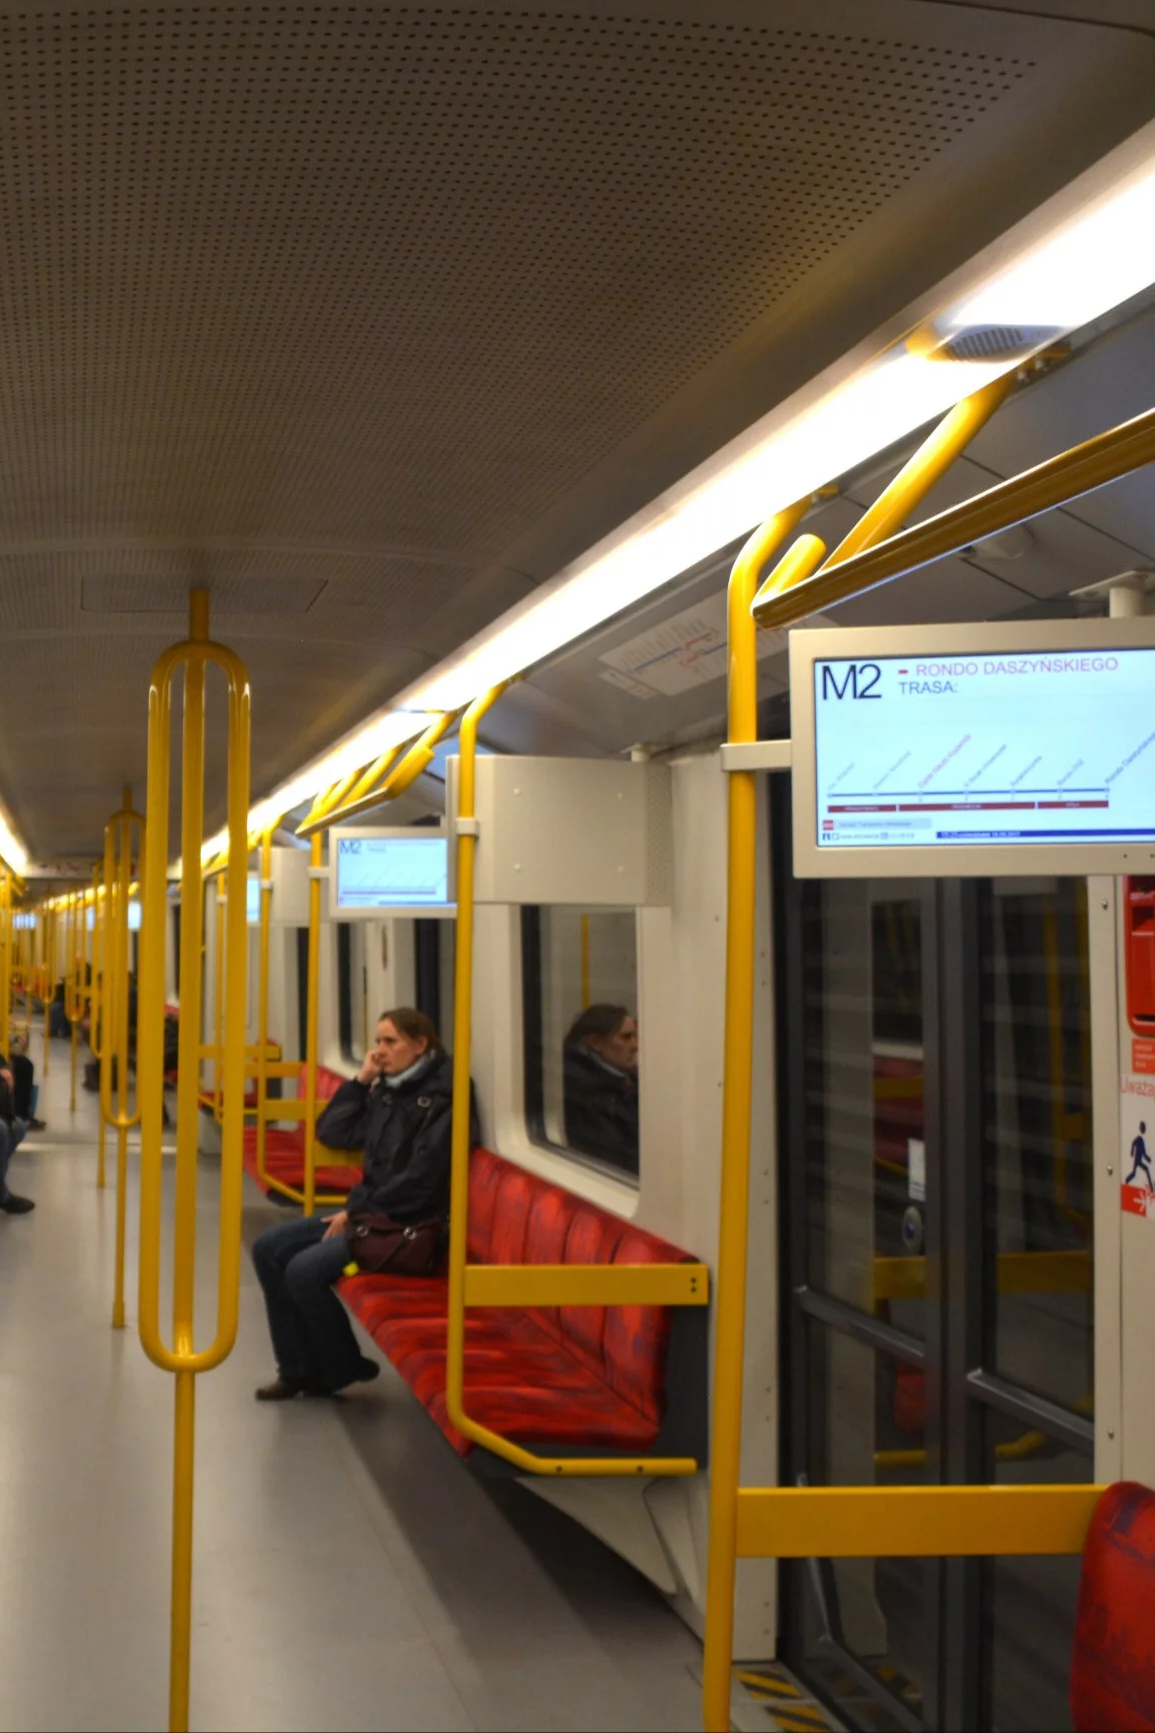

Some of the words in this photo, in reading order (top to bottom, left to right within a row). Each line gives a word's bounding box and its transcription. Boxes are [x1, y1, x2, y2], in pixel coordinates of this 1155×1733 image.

[916, 662, 978, 677] RONDO
[984, 656, 1118, 676] DASZYŃSKIEGO
[822, 663, 882, 701] M2
[898, 681, 958, 695] TRASA:
[340, 839, 362, 855] M2
